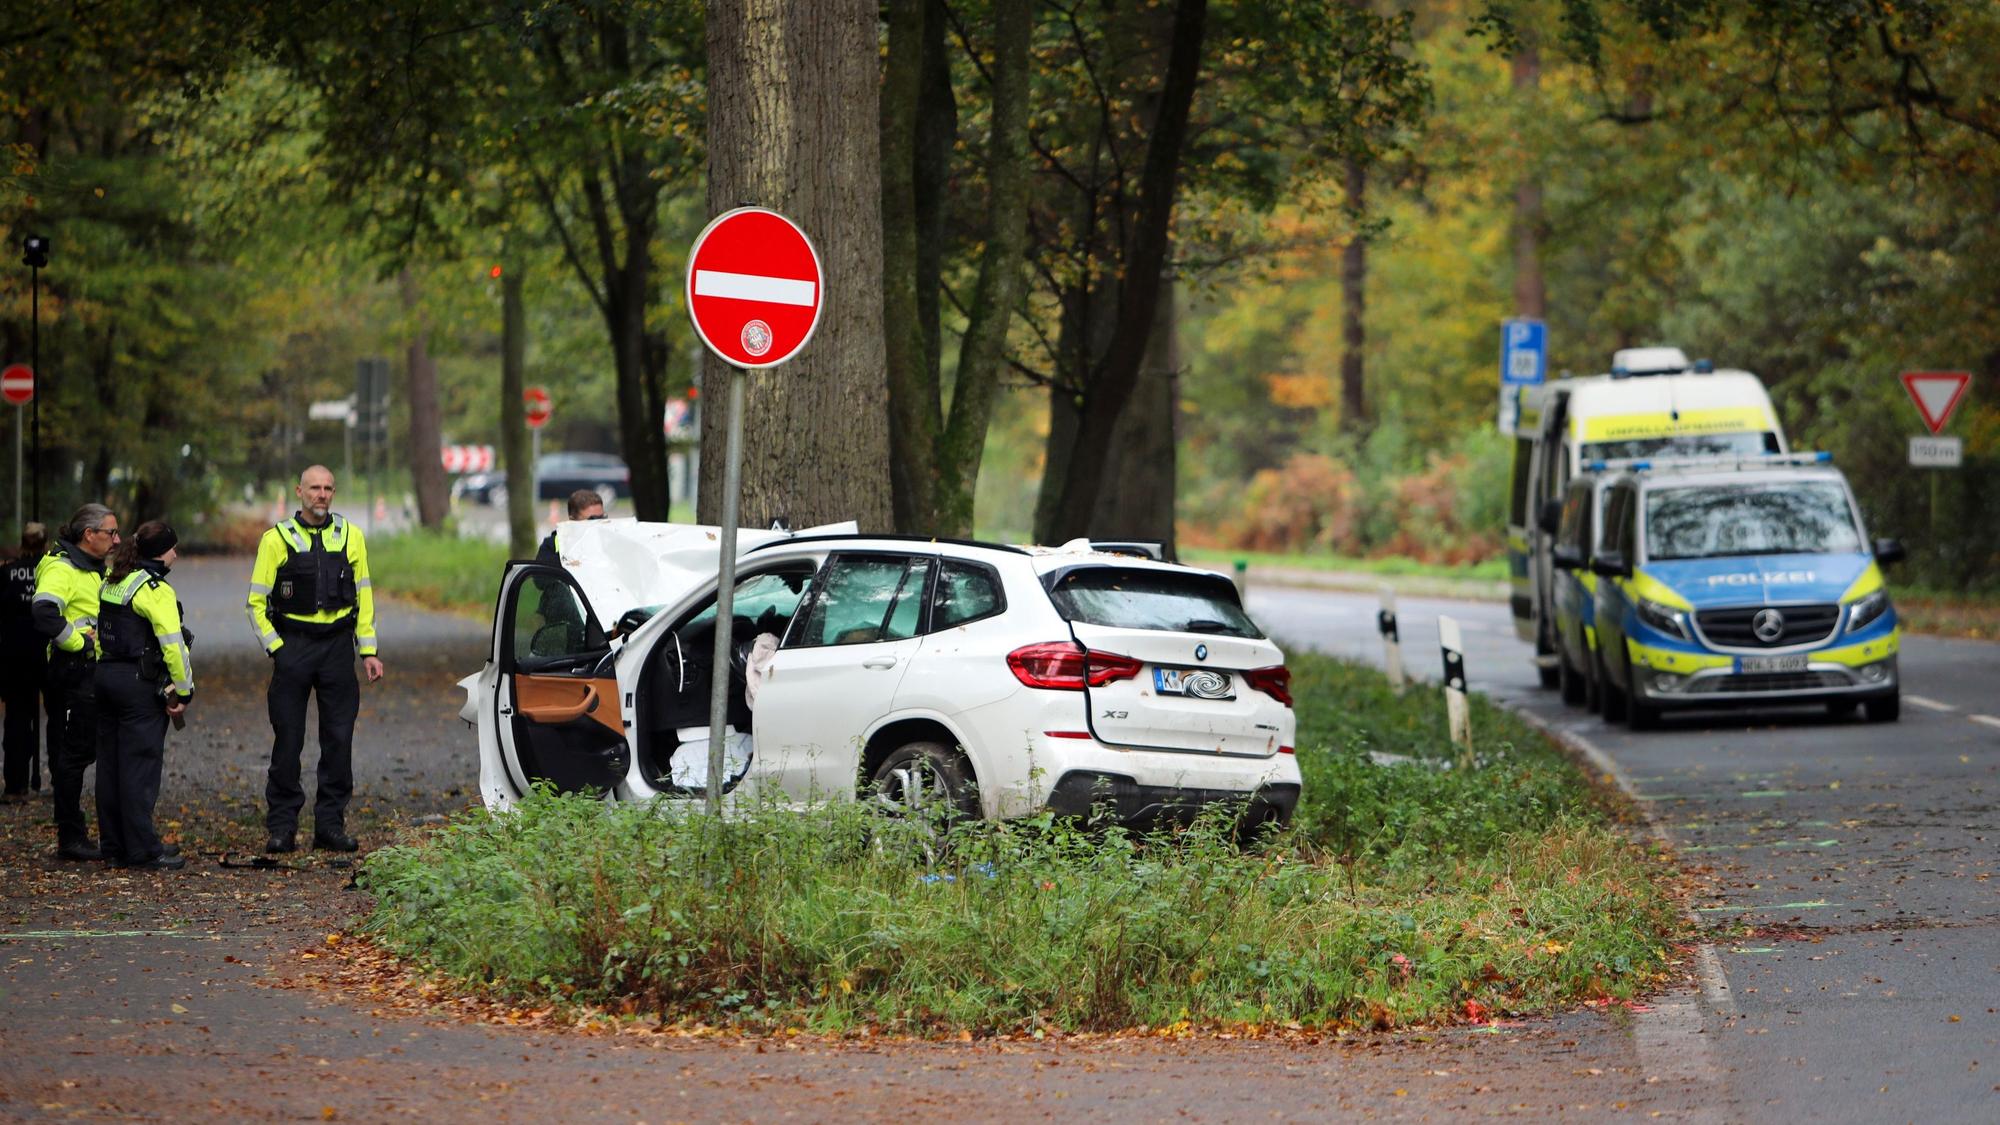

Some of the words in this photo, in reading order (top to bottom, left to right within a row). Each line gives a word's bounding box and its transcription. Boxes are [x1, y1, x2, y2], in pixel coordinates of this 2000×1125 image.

[1509, 321, 1531, 352] P
[10, 567, 36, 581] POLI
[1708, 571, 1815, 587] POLIZEI
[1163, 670, 1172, 689] K
[1102, 710, 1129, 719] X3
